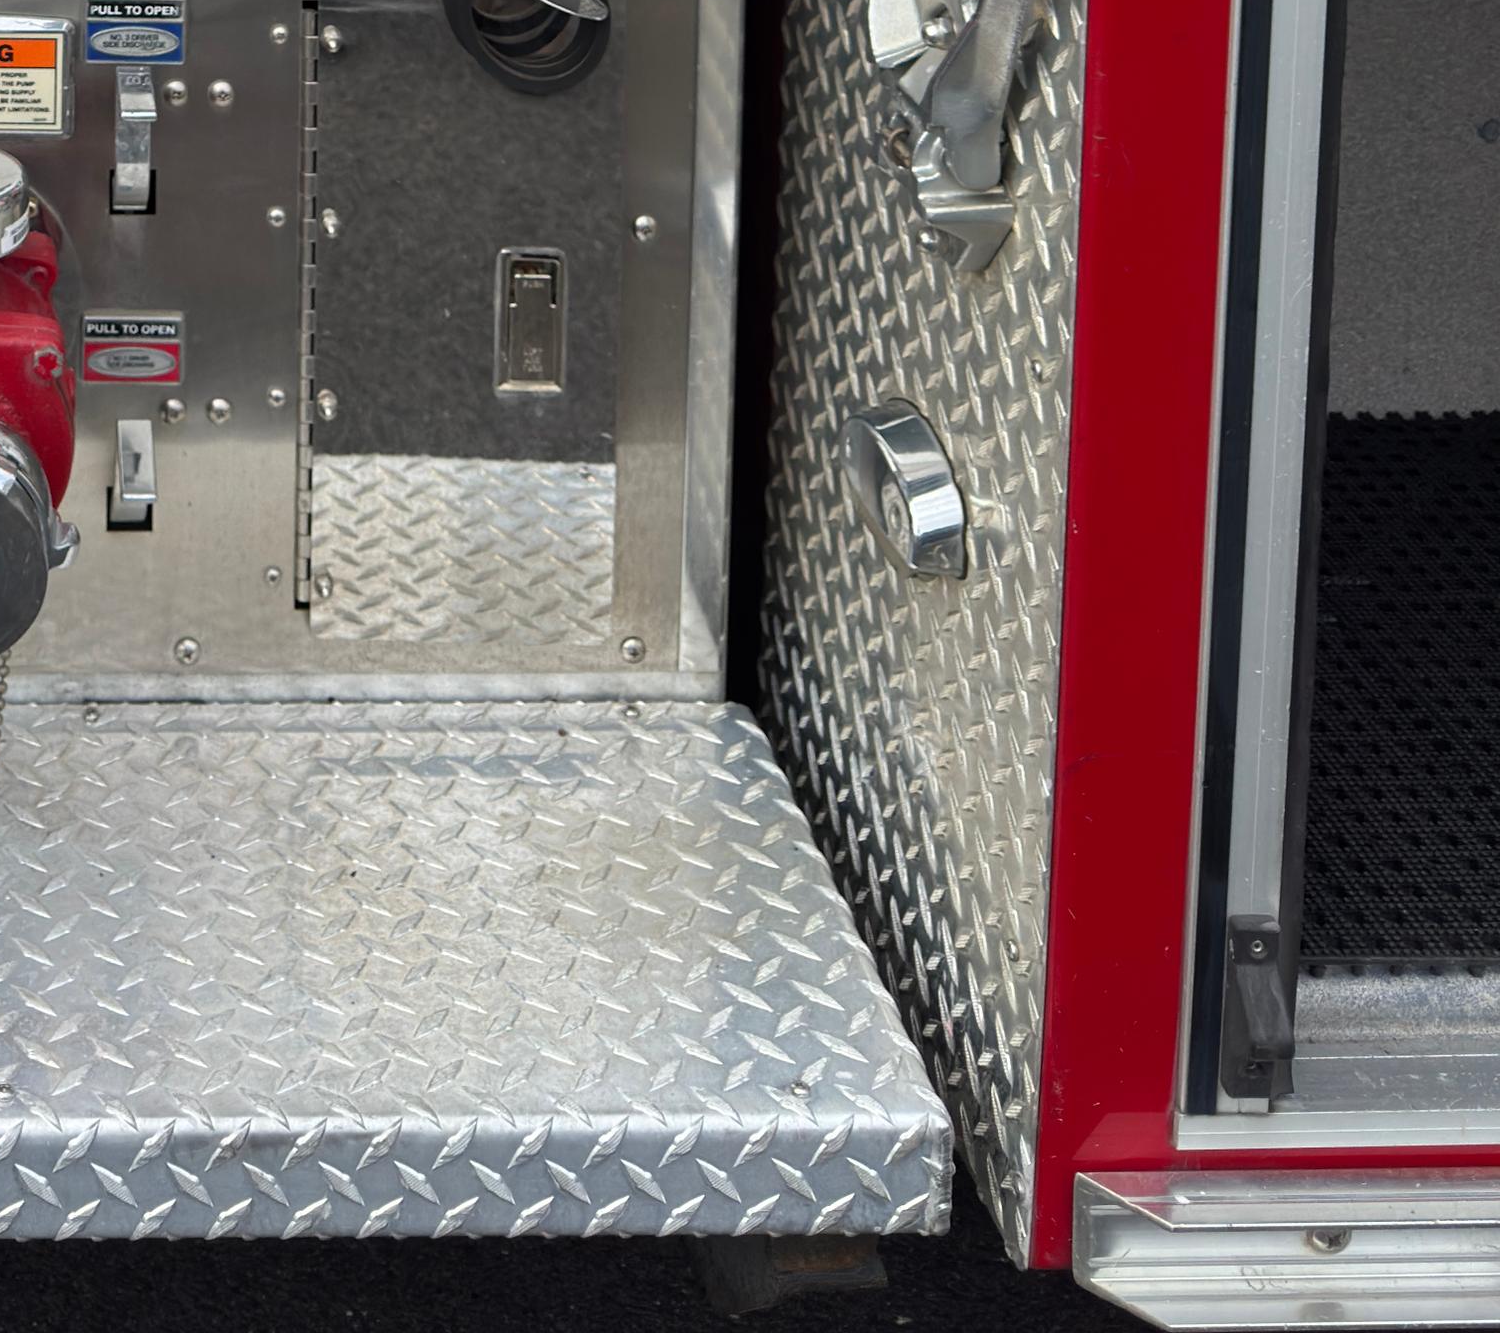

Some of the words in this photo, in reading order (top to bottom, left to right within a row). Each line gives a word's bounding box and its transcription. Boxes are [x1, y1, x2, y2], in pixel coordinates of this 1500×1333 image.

[91, 5, 122, 16] PULL
[124, 5, 141, 16] TO
[144, 6, 179, 16] OPEN
